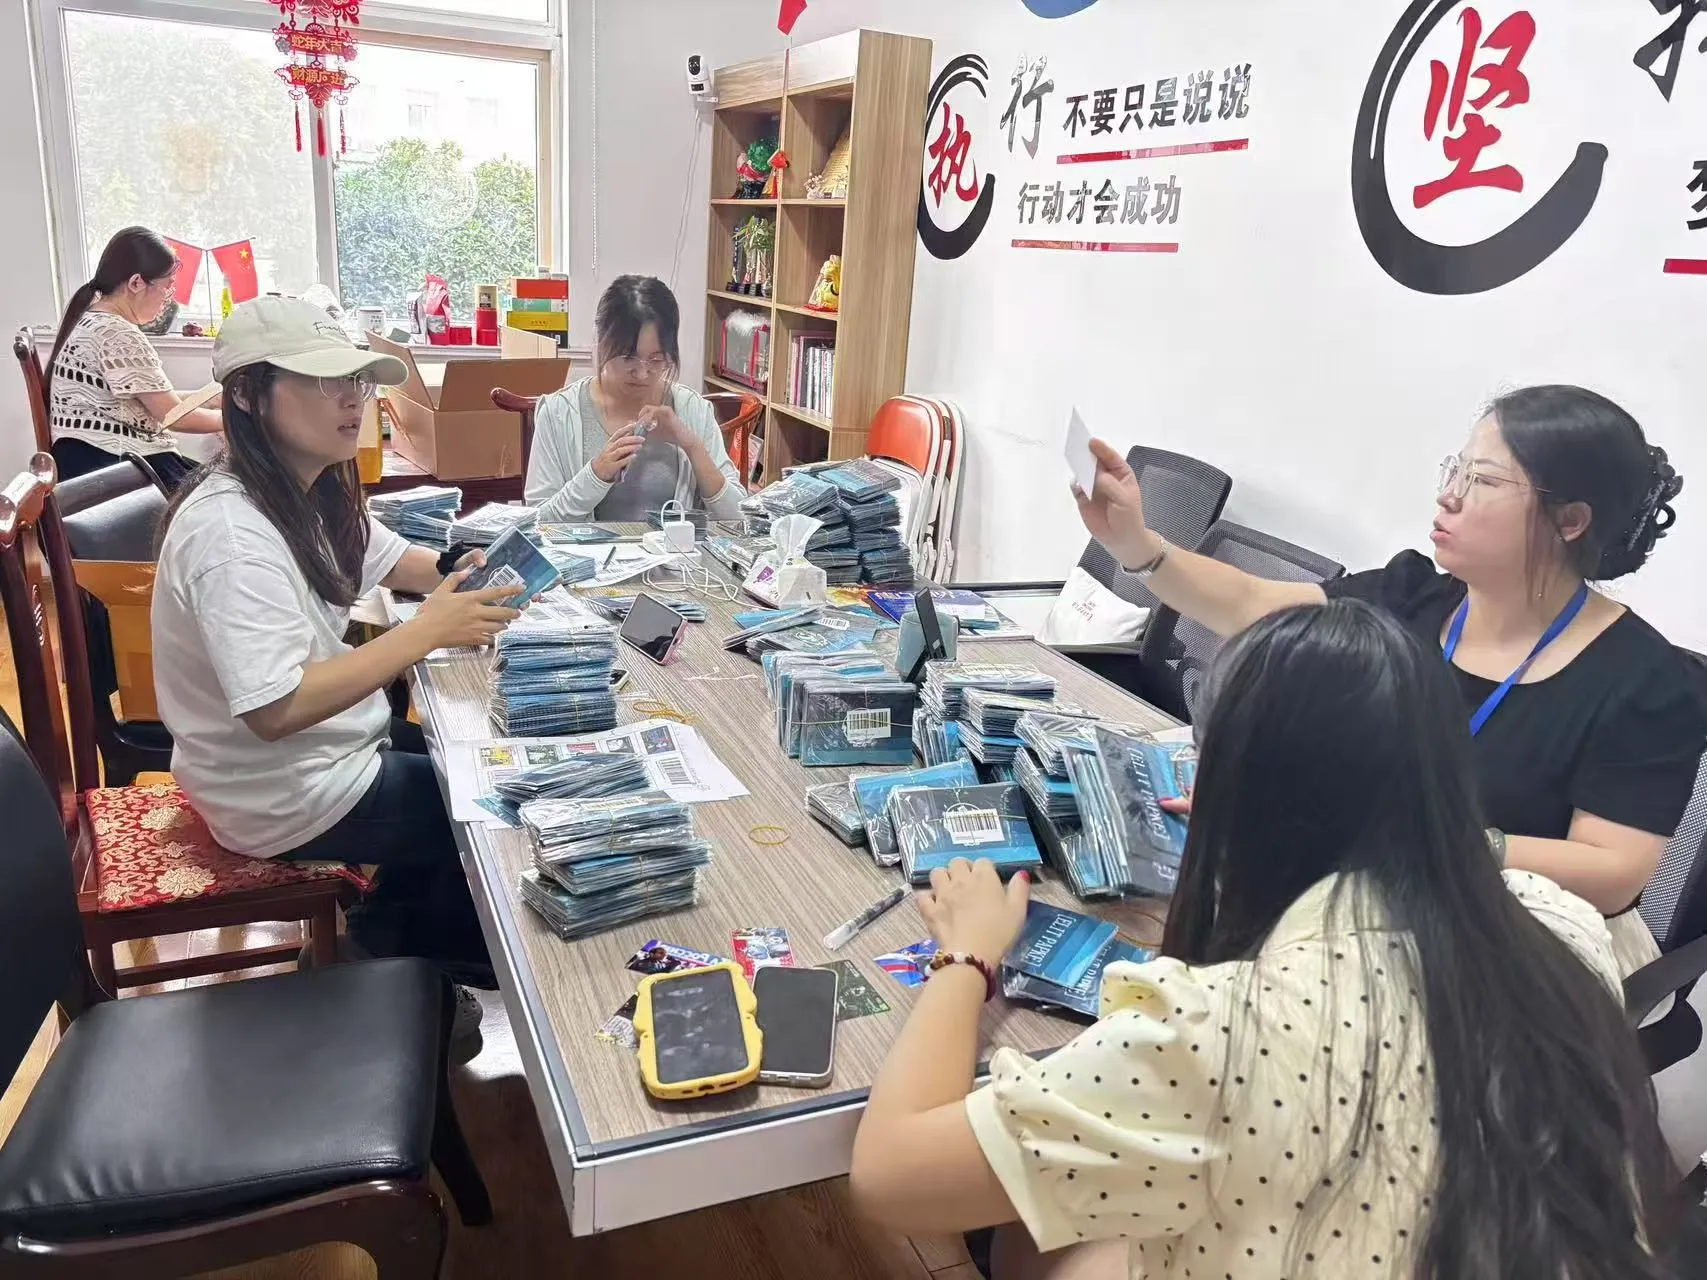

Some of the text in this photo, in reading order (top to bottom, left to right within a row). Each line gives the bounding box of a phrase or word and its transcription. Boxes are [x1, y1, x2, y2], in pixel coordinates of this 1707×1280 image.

[291, 35, 342, 53] 蛇年大吉
[292, 68, 344, 85] 财源广进
[1063, 63, 1252, 138] 不要只是说说
[1412, 6, 1536, 209] 坚
[1017, 175, 1182, 225] 行动才会成功
